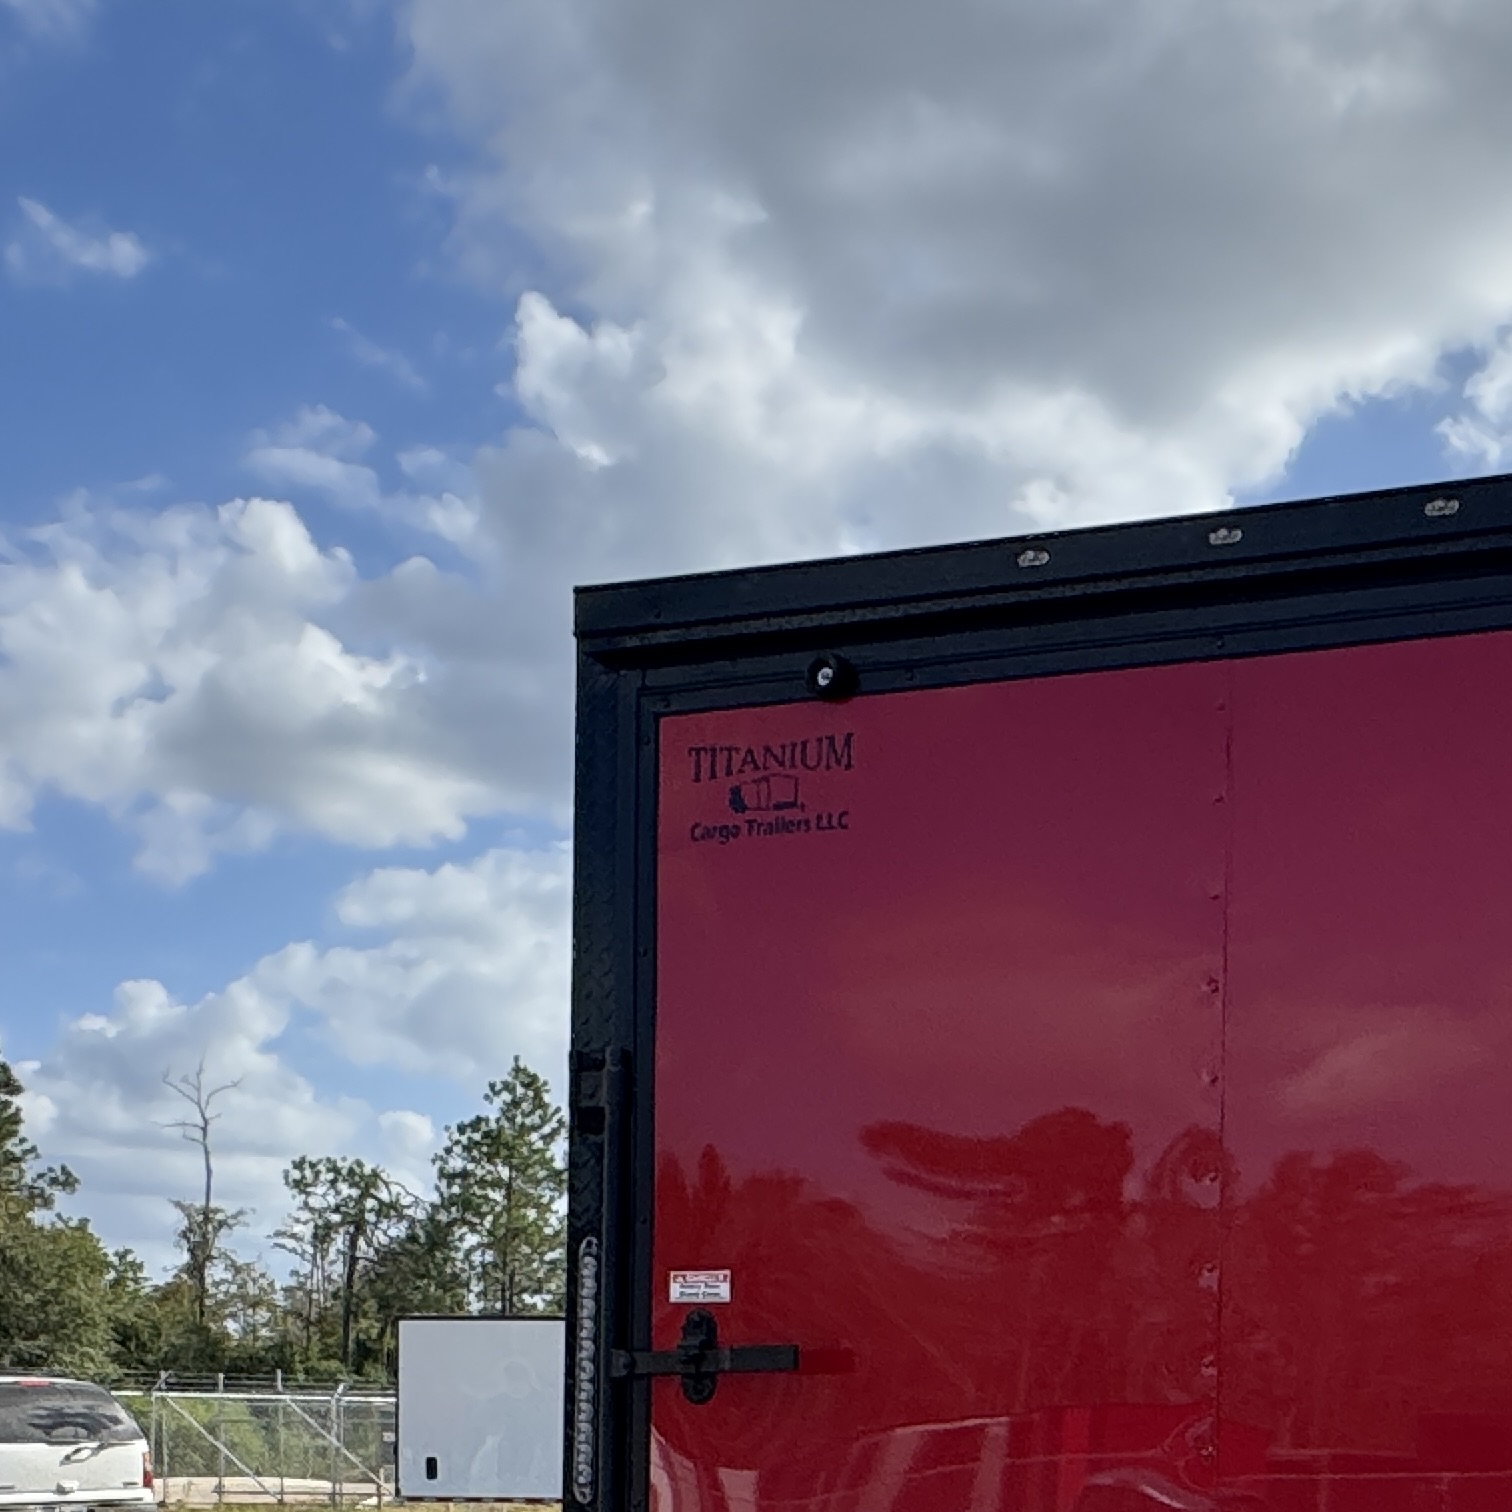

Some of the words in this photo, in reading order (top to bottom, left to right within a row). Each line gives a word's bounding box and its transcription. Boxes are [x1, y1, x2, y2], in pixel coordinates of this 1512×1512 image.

[687, 732, 855, 783] TITANIUM
[690, 822, 741, 845] Cargo
[744, 816, 812, 837] Trailers
[816, 811, 849, 831] LLC
